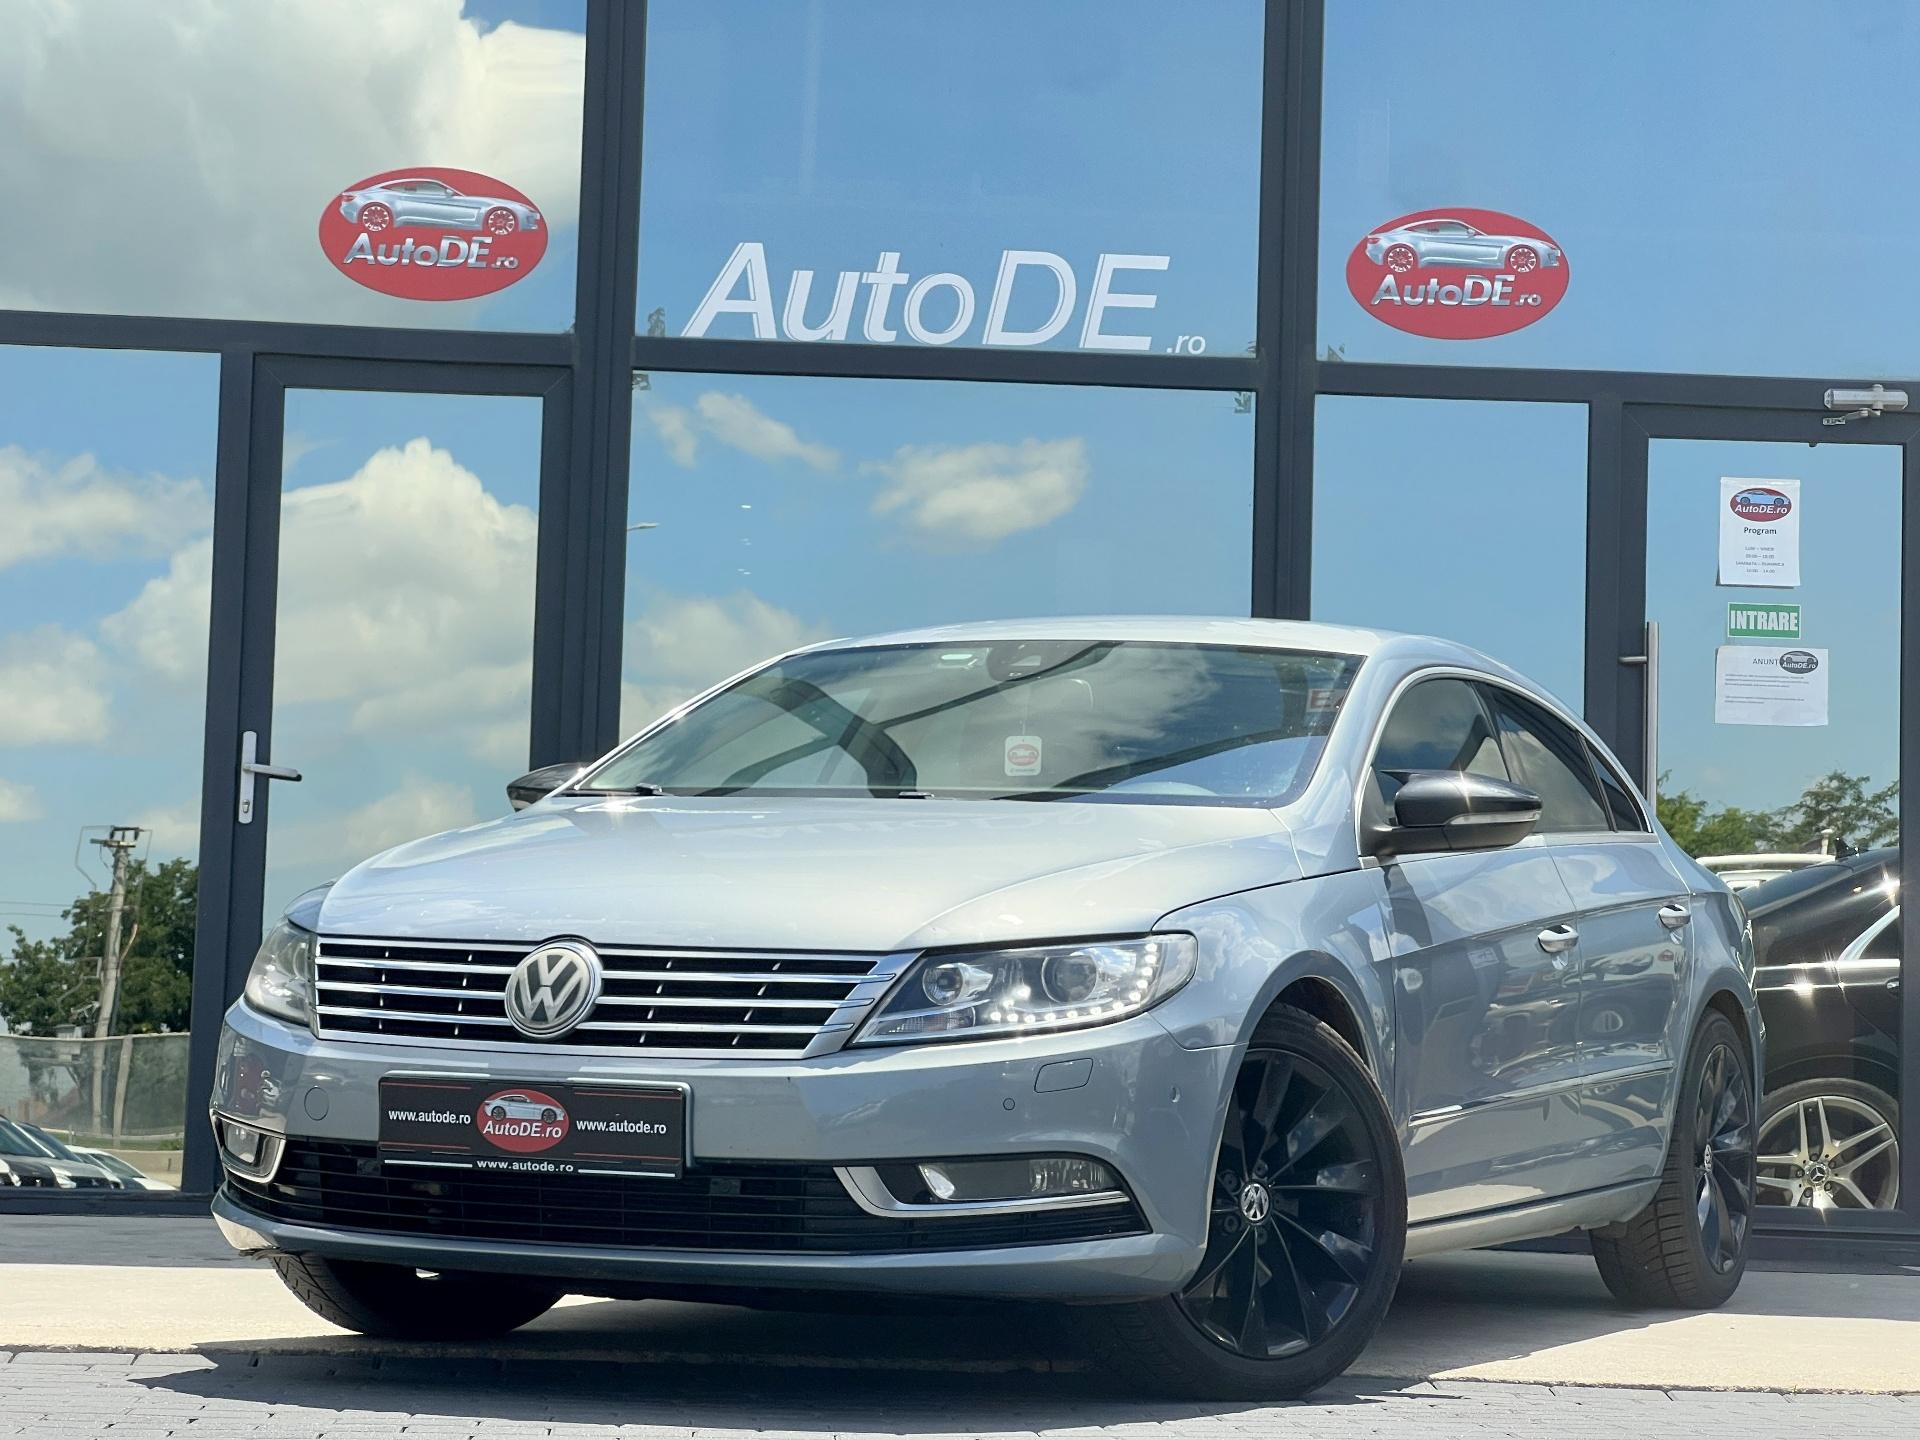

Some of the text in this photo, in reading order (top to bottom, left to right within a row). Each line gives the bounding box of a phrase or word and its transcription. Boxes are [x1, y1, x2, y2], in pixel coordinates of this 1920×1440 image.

[1734, 504, 1788, 514] AutoDE.ro
[1743, 526, 1777, 535] Program
[1730, 610, 1798, 631] INTRARE
[388, 1109, 471, 1124] www.autode.ro
[483, 1120, 563, 1138] AutoDE.ro
[576, 1118, 667, 1135] www.autode.ro
[476, 1160, 574, 1172] www.autode.ro
